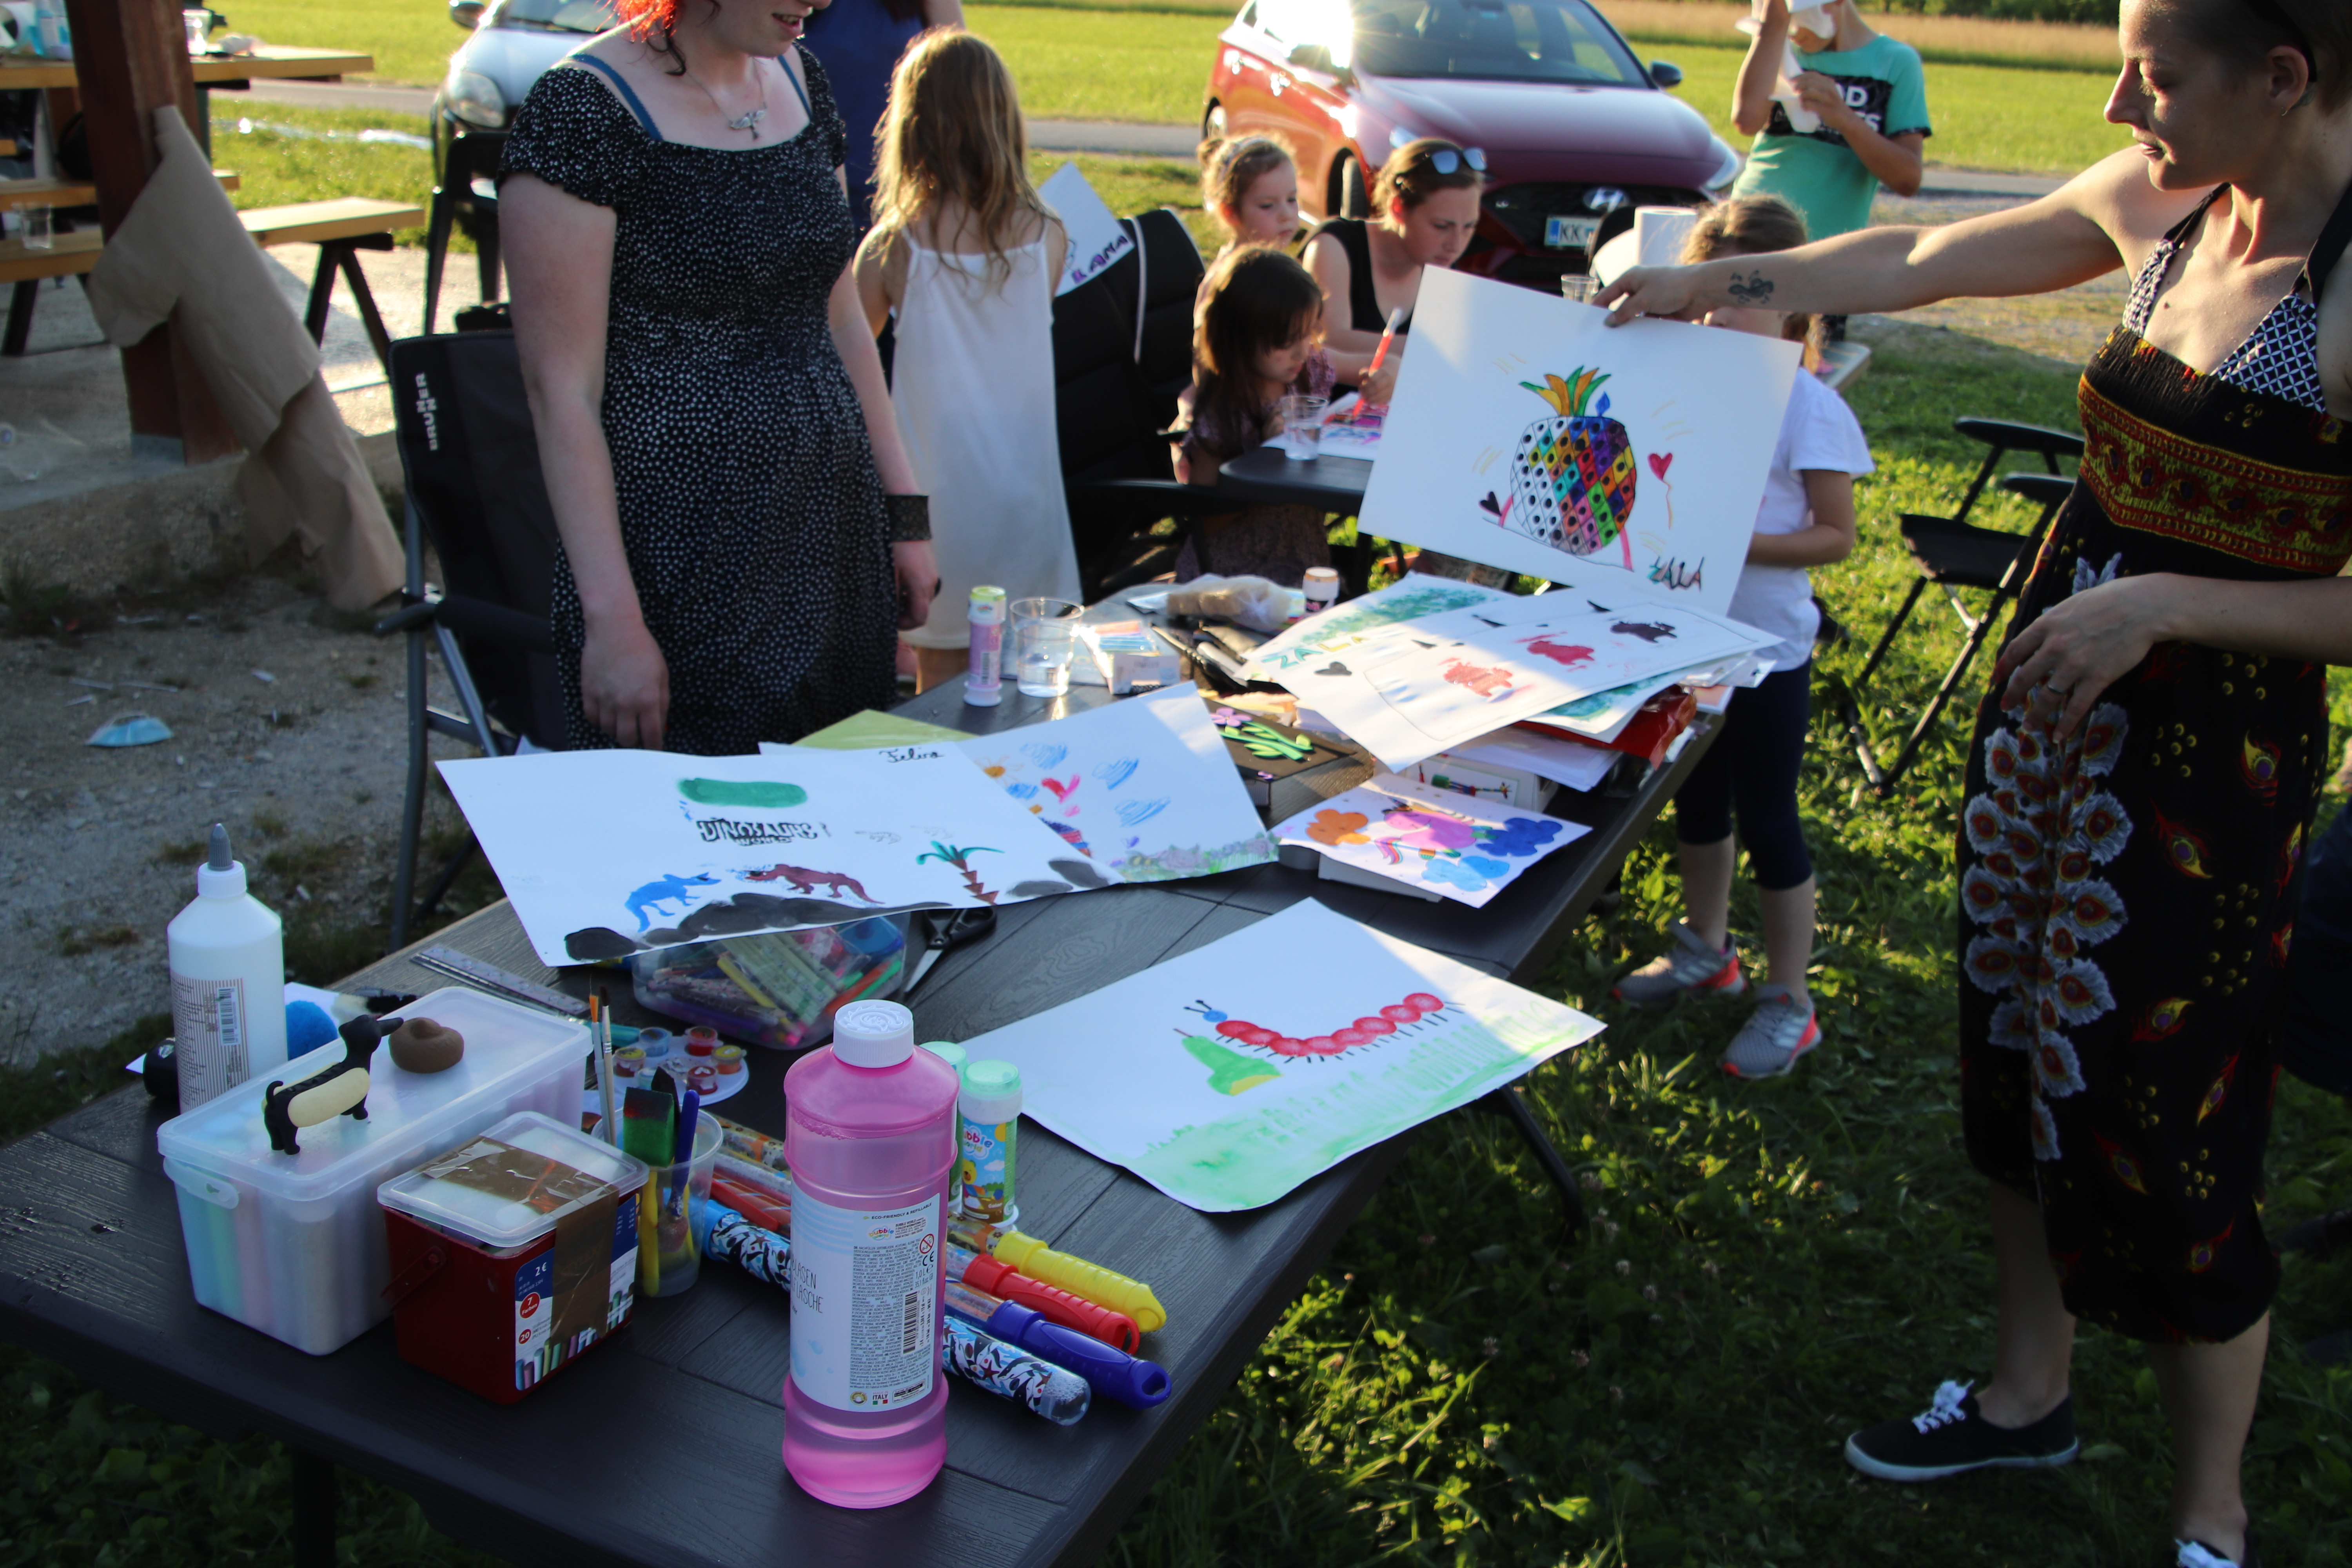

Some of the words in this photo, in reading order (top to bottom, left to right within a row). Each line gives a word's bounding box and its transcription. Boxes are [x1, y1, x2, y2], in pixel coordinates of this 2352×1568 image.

[416, 372, 438, 451] BRUNNER
[1261, 636, 1370, 669] ZALA
[910, 1202, 932, 1214] REFILLABLE
[535, 1266, 541, 1277] 2
[542, 1262, 547, 1272] €
[527, 1296, 533, 1306] 7
[522, 1303, 537, 1315] Farben
[520, 1334, 530, 1342] 20
